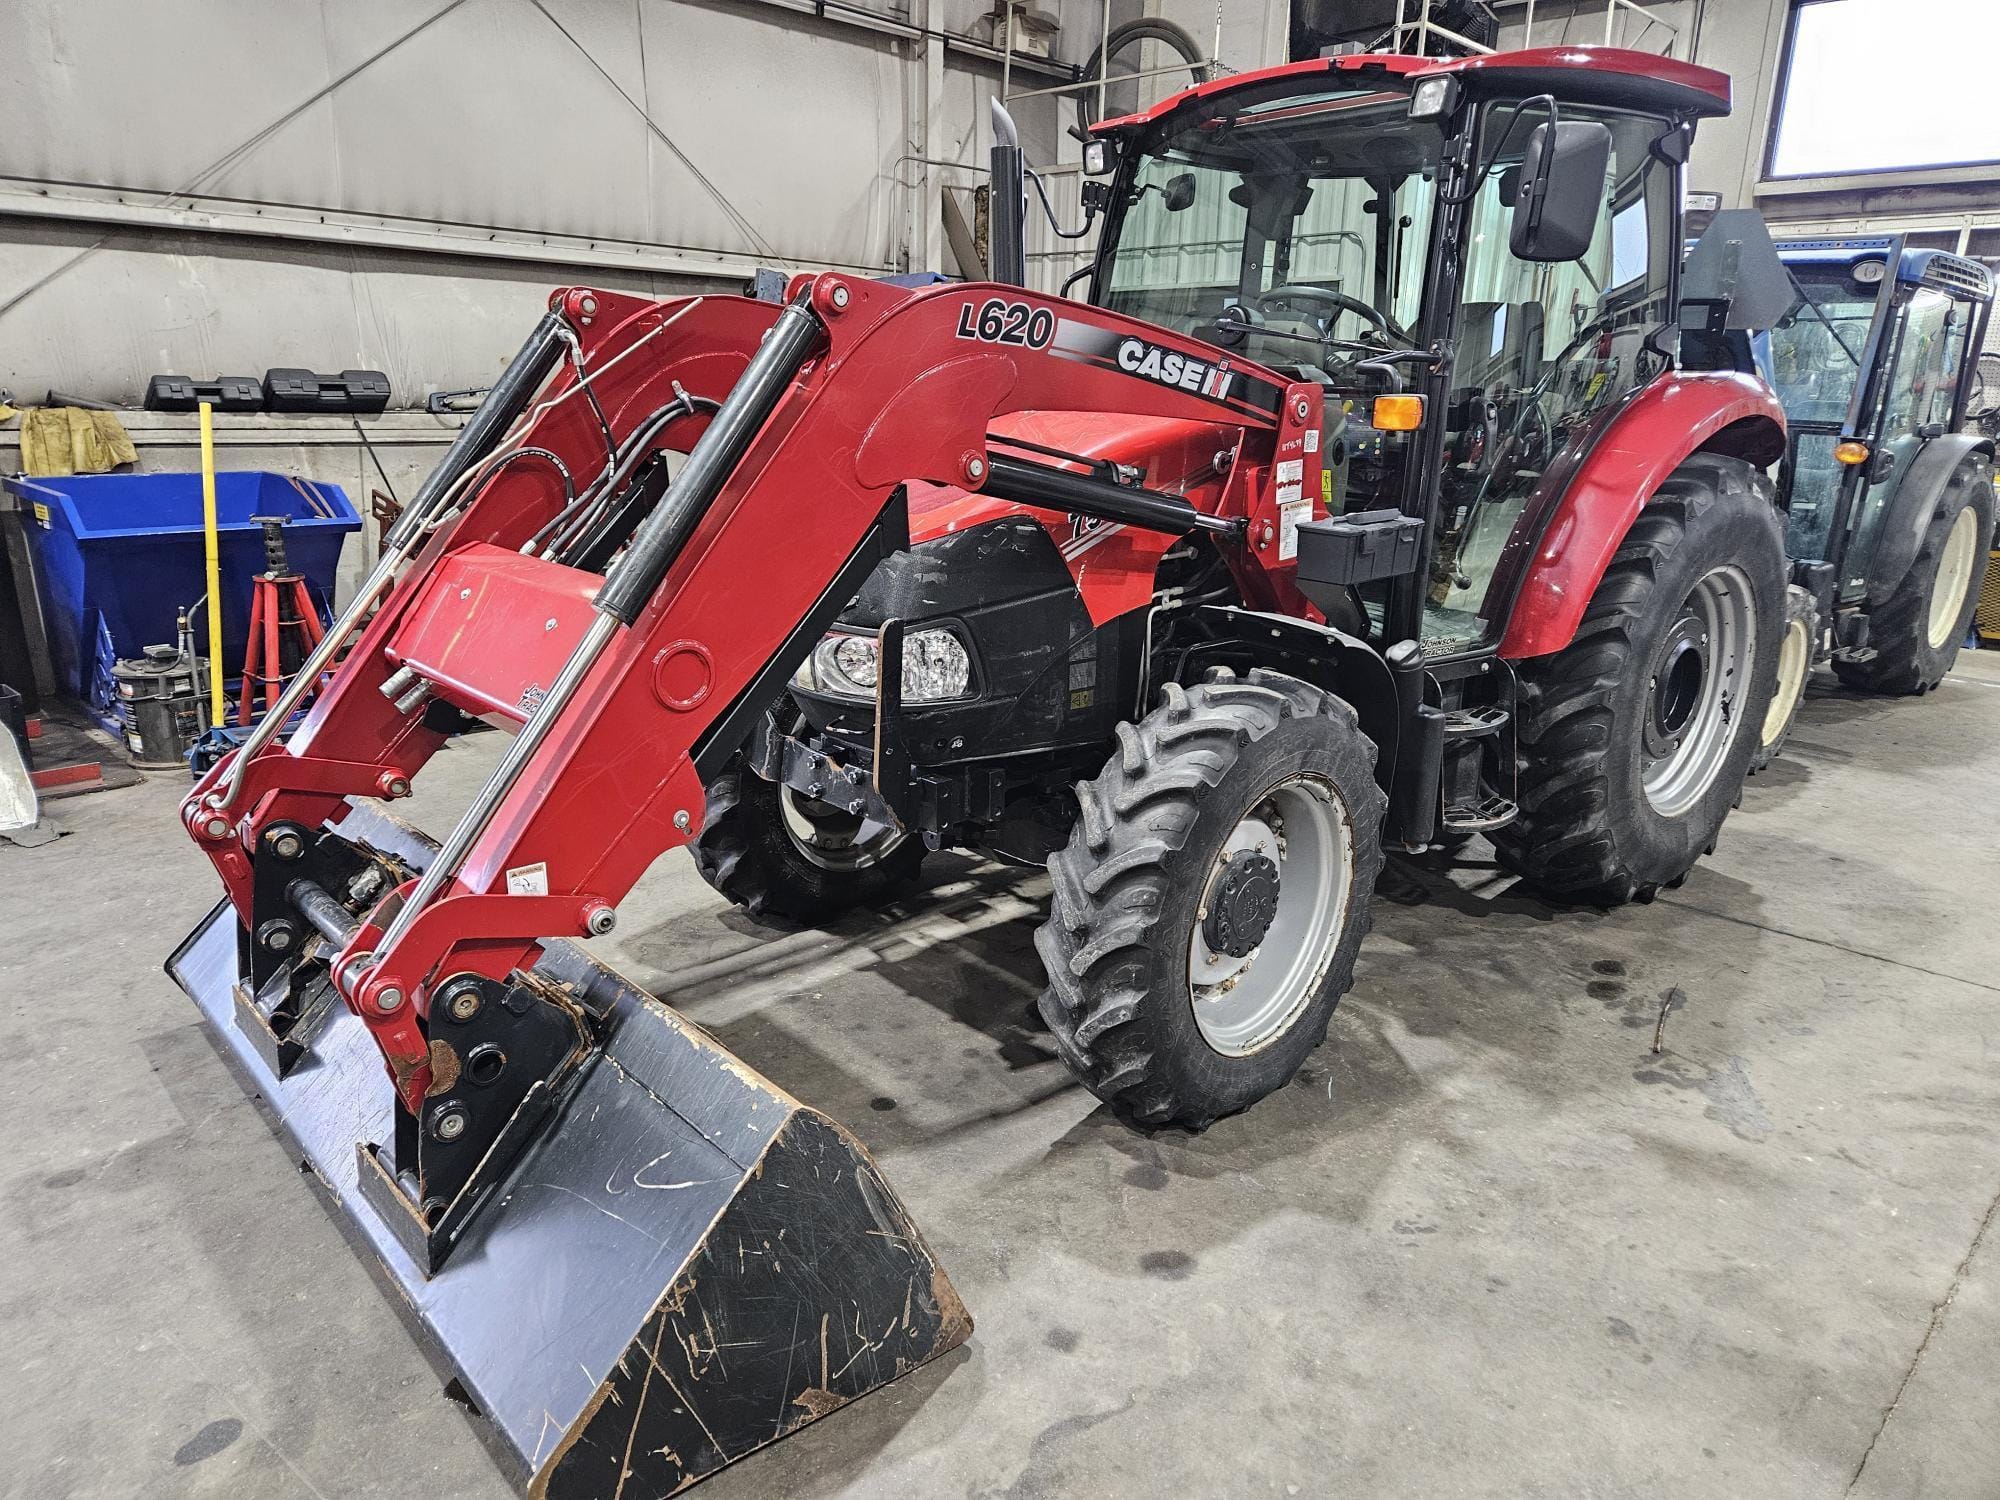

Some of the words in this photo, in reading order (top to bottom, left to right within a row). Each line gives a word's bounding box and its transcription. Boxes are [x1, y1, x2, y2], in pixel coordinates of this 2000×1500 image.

[955, 298, 1054, 350] L620
[1117, 336, 1206, 391] CASE
[1421, 637, 1457, 649] JOHNSON
[1423, 646, 1455, 657] TRACTOR
[524, 683, 546, 701] JOHN
[515, 695, 539, 713] TRAC
